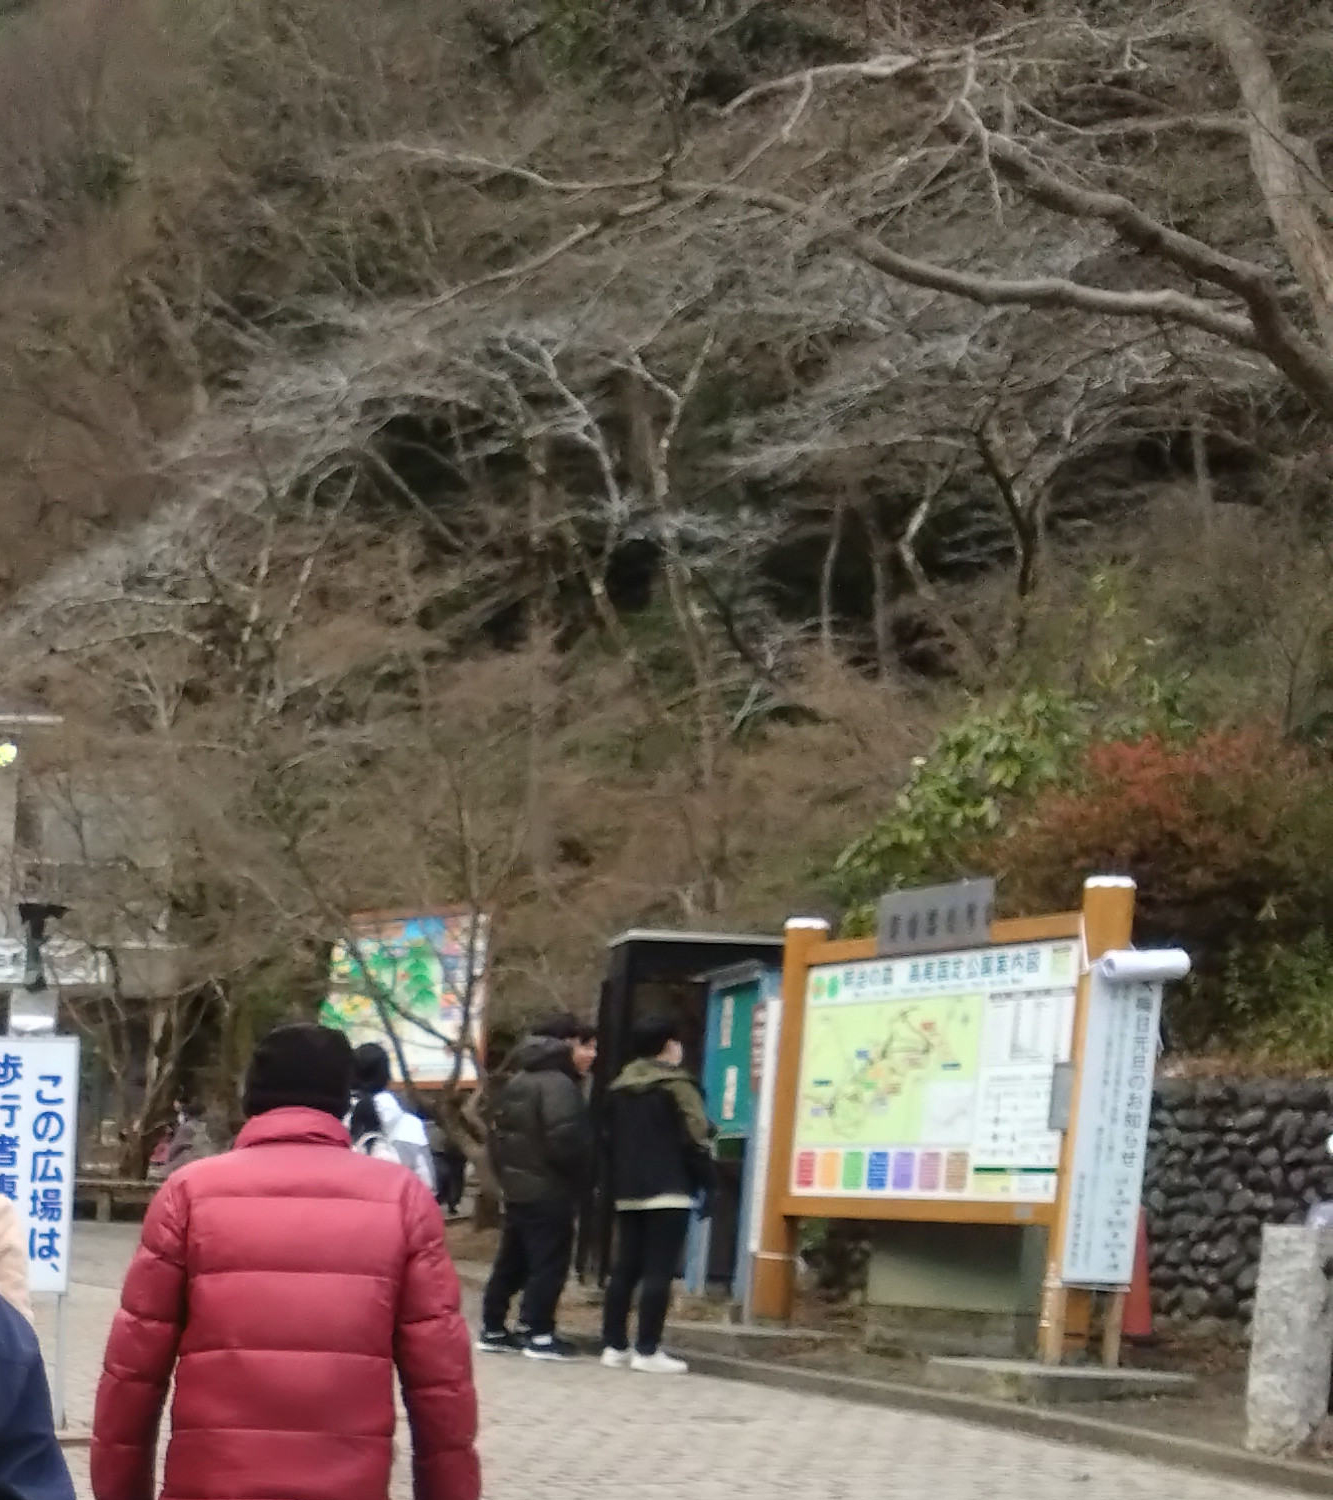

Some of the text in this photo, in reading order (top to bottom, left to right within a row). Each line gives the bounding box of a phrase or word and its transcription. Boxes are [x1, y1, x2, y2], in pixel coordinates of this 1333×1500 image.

[28, 1074, 65, 1273] この広場は、
